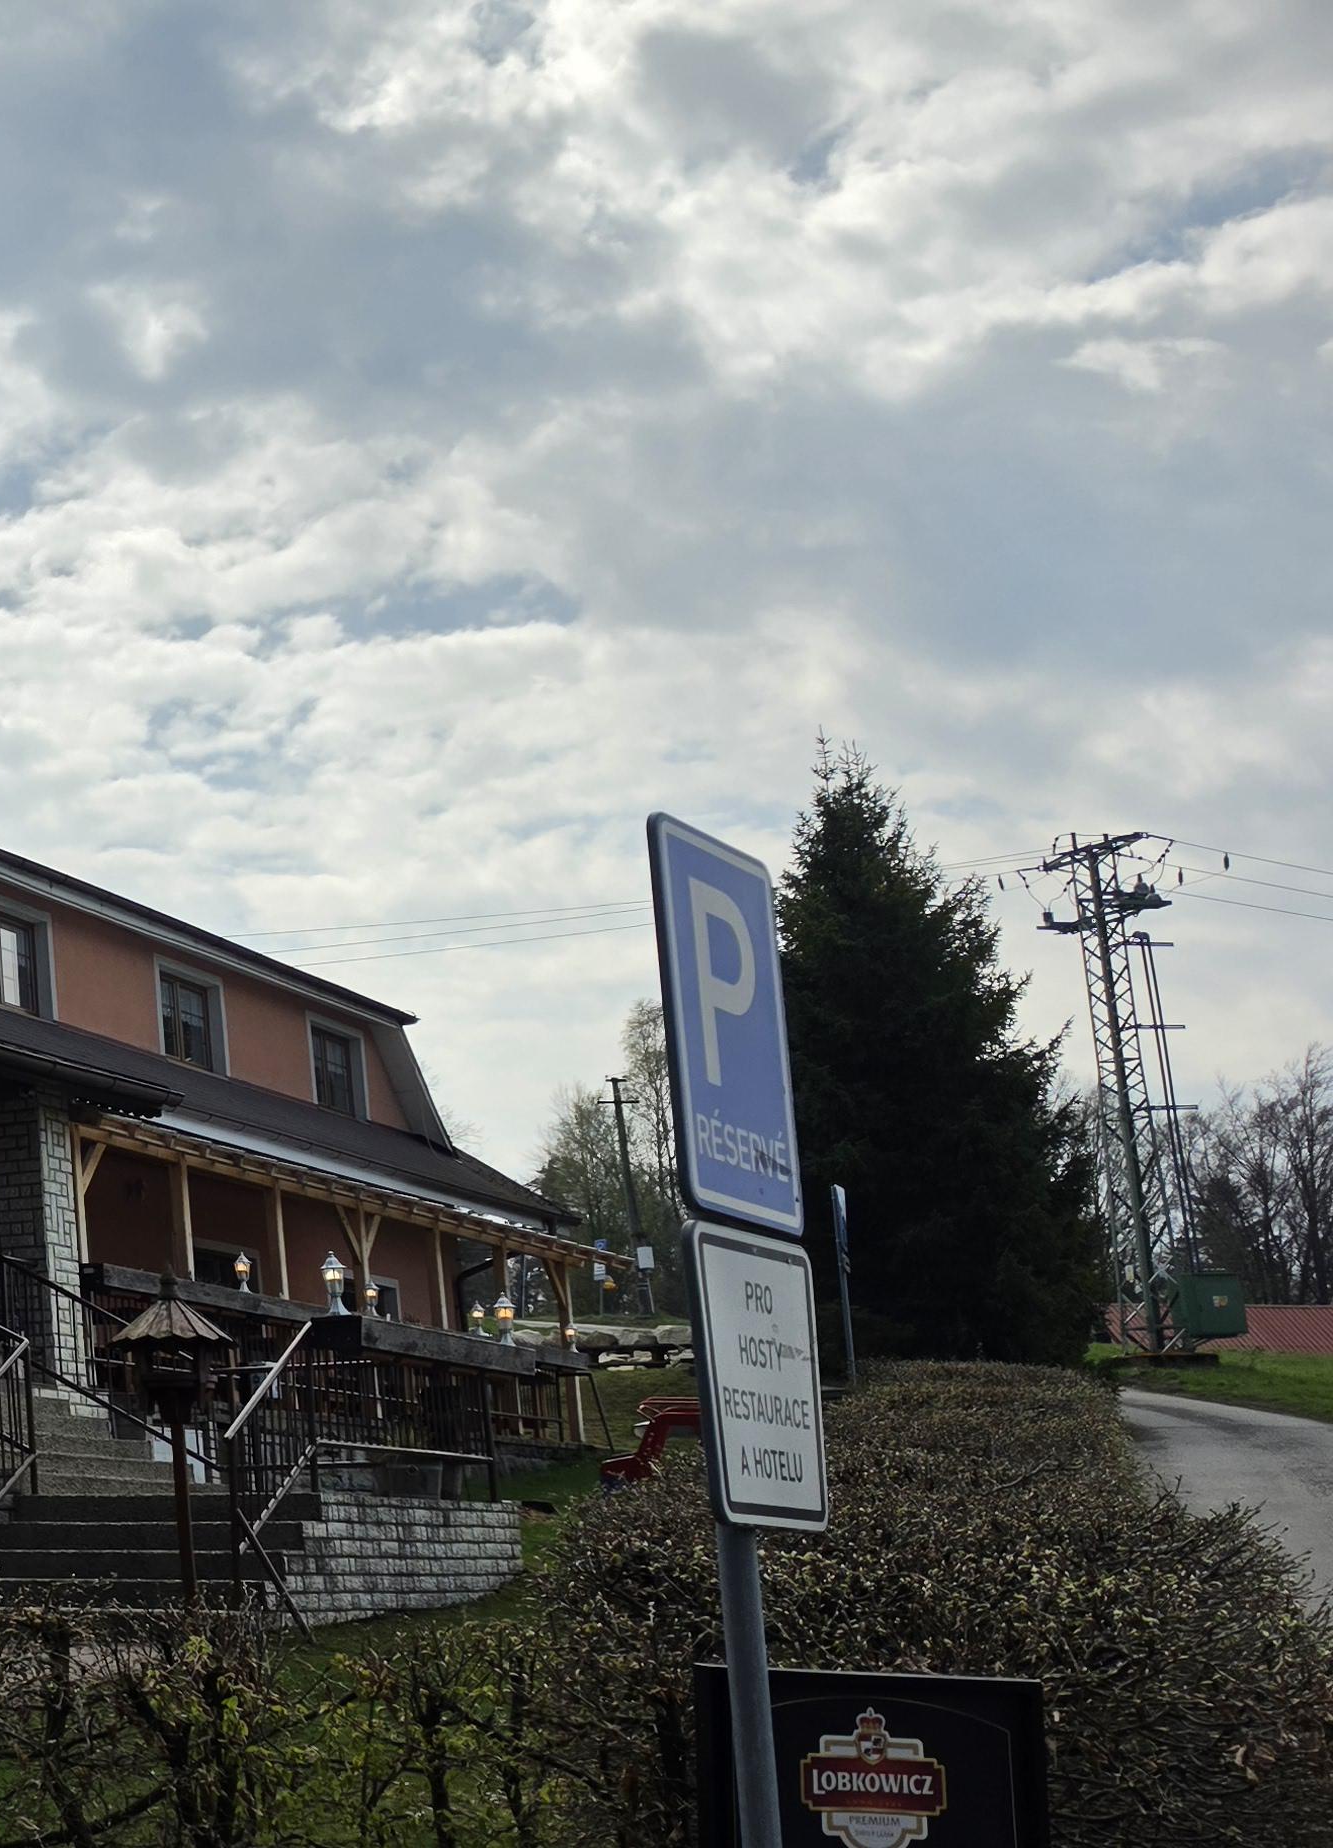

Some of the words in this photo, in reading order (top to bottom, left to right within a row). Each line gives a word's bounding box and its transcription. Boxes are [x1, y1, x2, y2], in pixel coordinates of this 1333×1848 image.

[688, 875, 756, 1087] P
[695, 1108, 790, 1183] RÉSERVÉ
[744, 1280, 773, 1315] PRO
[738, 1334, 783, 1372] HOSTY
[722, 1386, 811, 1430] RESTAURACE
[741, 1445, 751, 1476] A
[754, 1448, 803, 1483] HOTELU
[812, 1768, 934, 1796] LOBKOWICZ
[848, 1815, 901, 1826] PREMIUM
